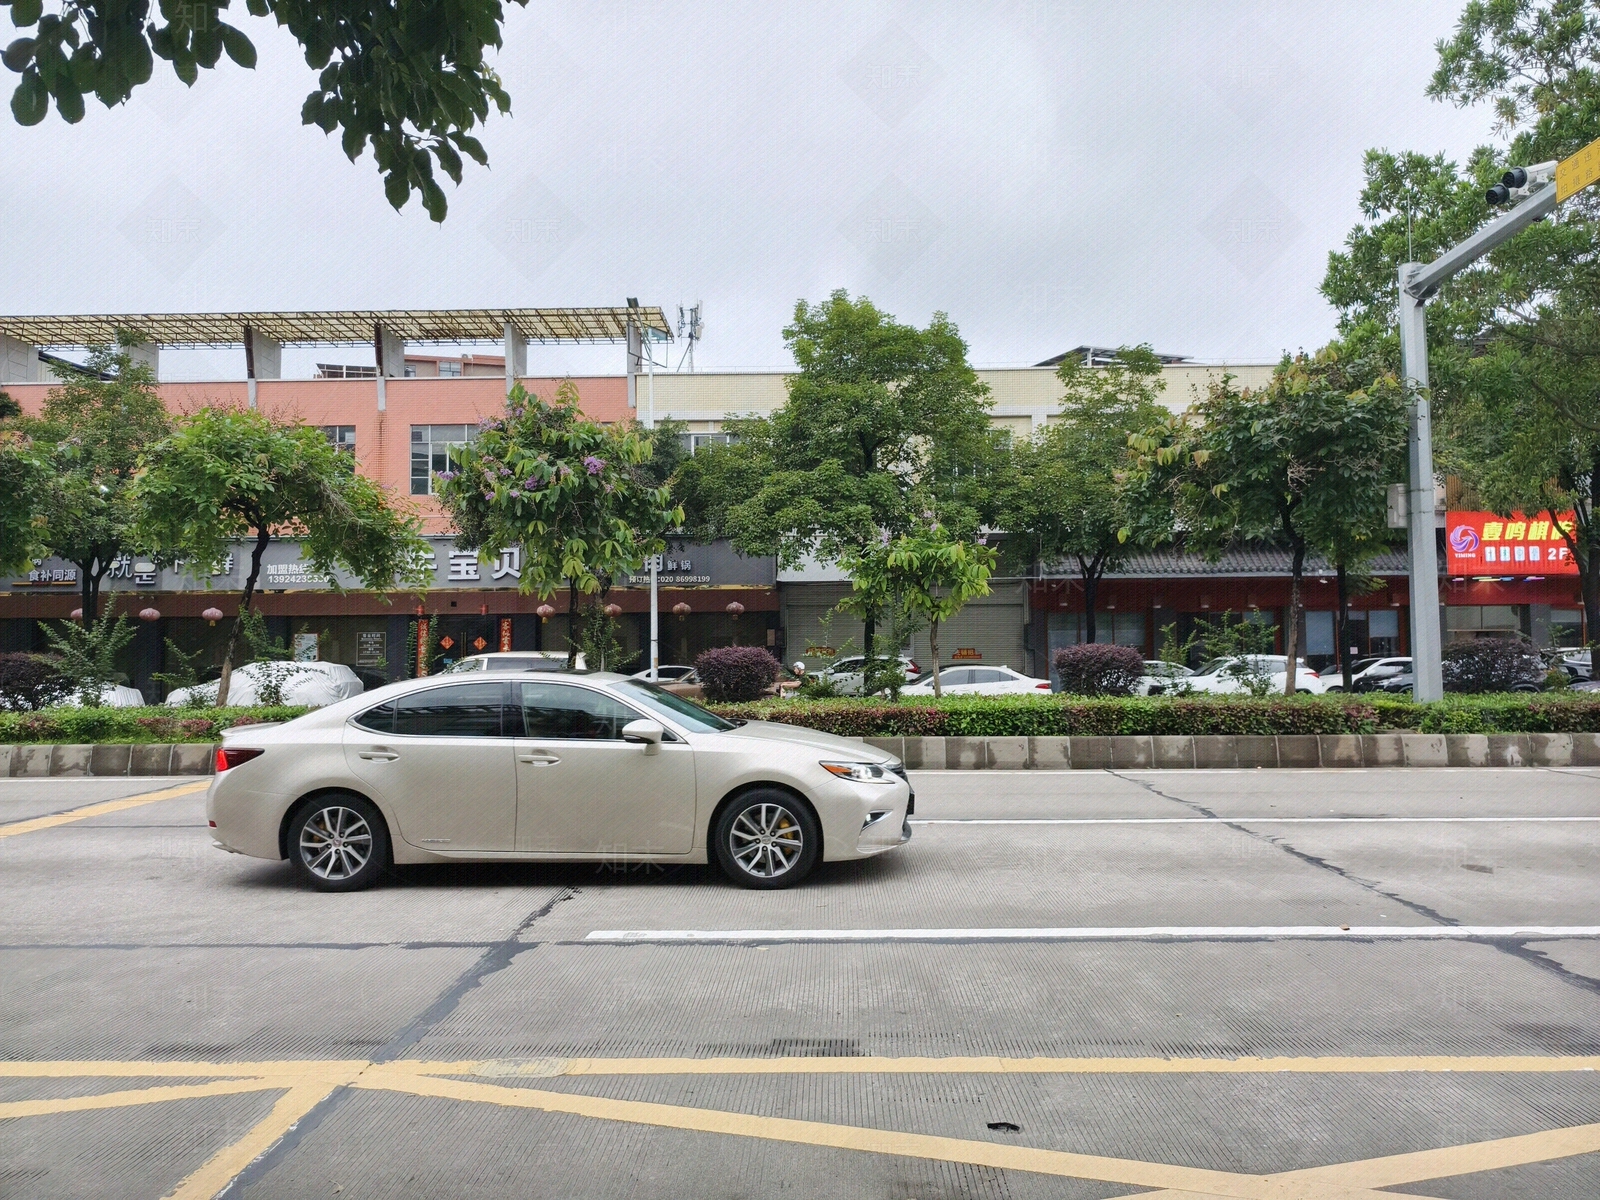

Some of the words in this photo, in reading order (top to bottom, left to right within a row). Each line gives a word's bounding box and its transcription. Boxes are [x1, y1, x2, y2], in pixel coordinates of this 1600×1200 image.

[1547, 547, 1569, 561] 2F
[28, 569, 77, 582] 食补同源
[675, 575, 711, 584] 86998199
